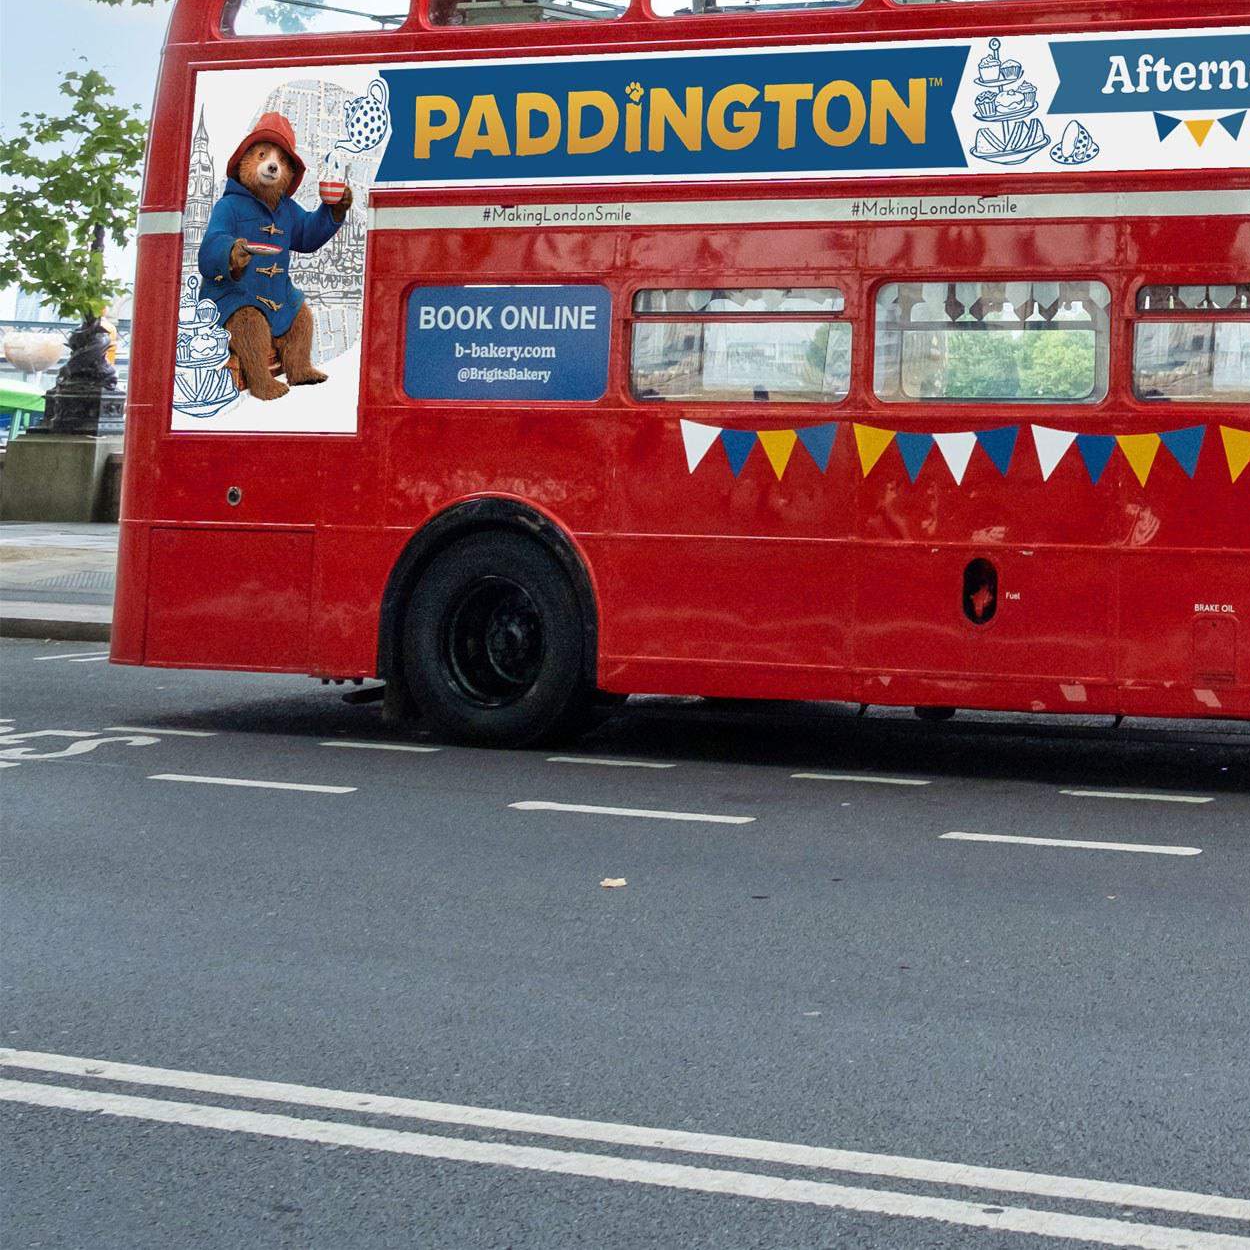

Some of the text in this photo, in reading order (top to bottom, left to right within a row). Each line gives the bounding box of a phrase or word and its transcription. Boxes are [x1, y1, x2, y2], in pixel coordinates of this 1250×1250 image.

[482, 205, 632, 226] #MakingLondonSmile
[851, 196, 1018, 221] #MakingLondonSmile
[419, 305, 597, 330] BOOK ONLINE
[455, 342, 557, 362] b-bakery.com
[457, 367, 552, 384] @BrigitsBakery
[1005, 591, 1021, 600] Fuel
[1194, 603, 1236, 613] BRAKE OIL
